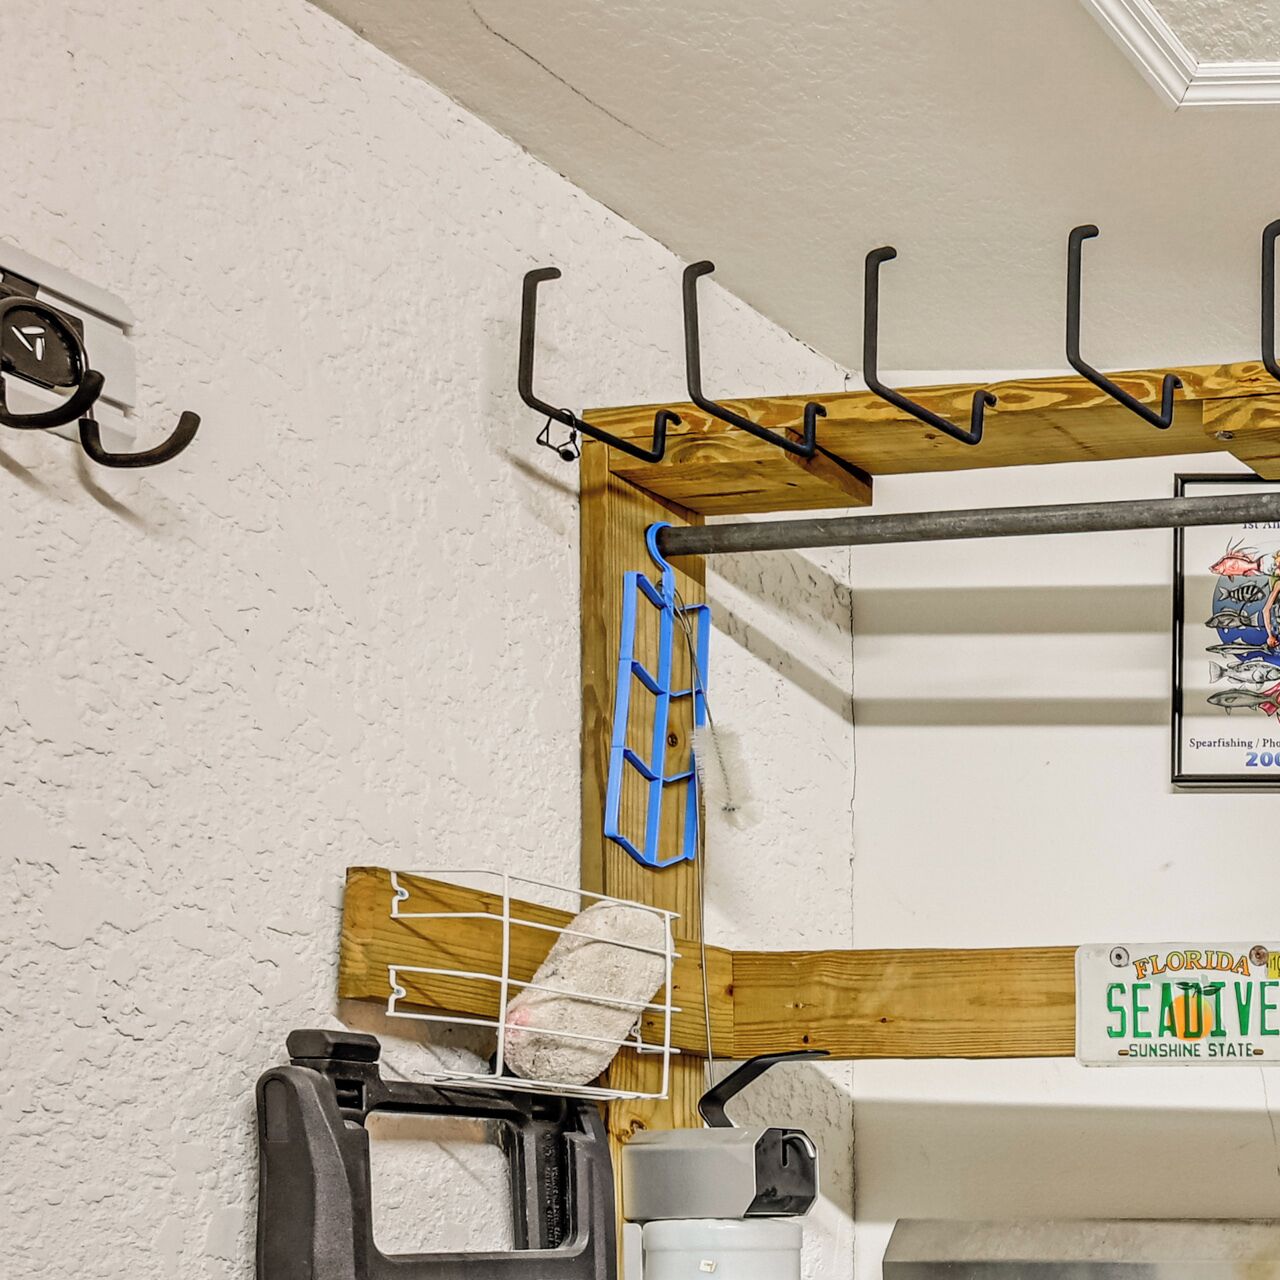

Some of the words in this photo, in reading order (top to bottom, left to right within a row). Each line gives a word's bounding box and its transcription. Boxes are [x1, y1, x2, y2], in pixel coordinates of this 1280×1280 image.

[1189, 738, 1253, 749] Spearfishing
[1133, 950, 1251, 980] FLORIDA
[1106, 981, 1280, 1038] SEADIVE
[1129, 1043, 1201, 1057] SUNSHINE
[1208, 1042, 1253, 1057] STATE
